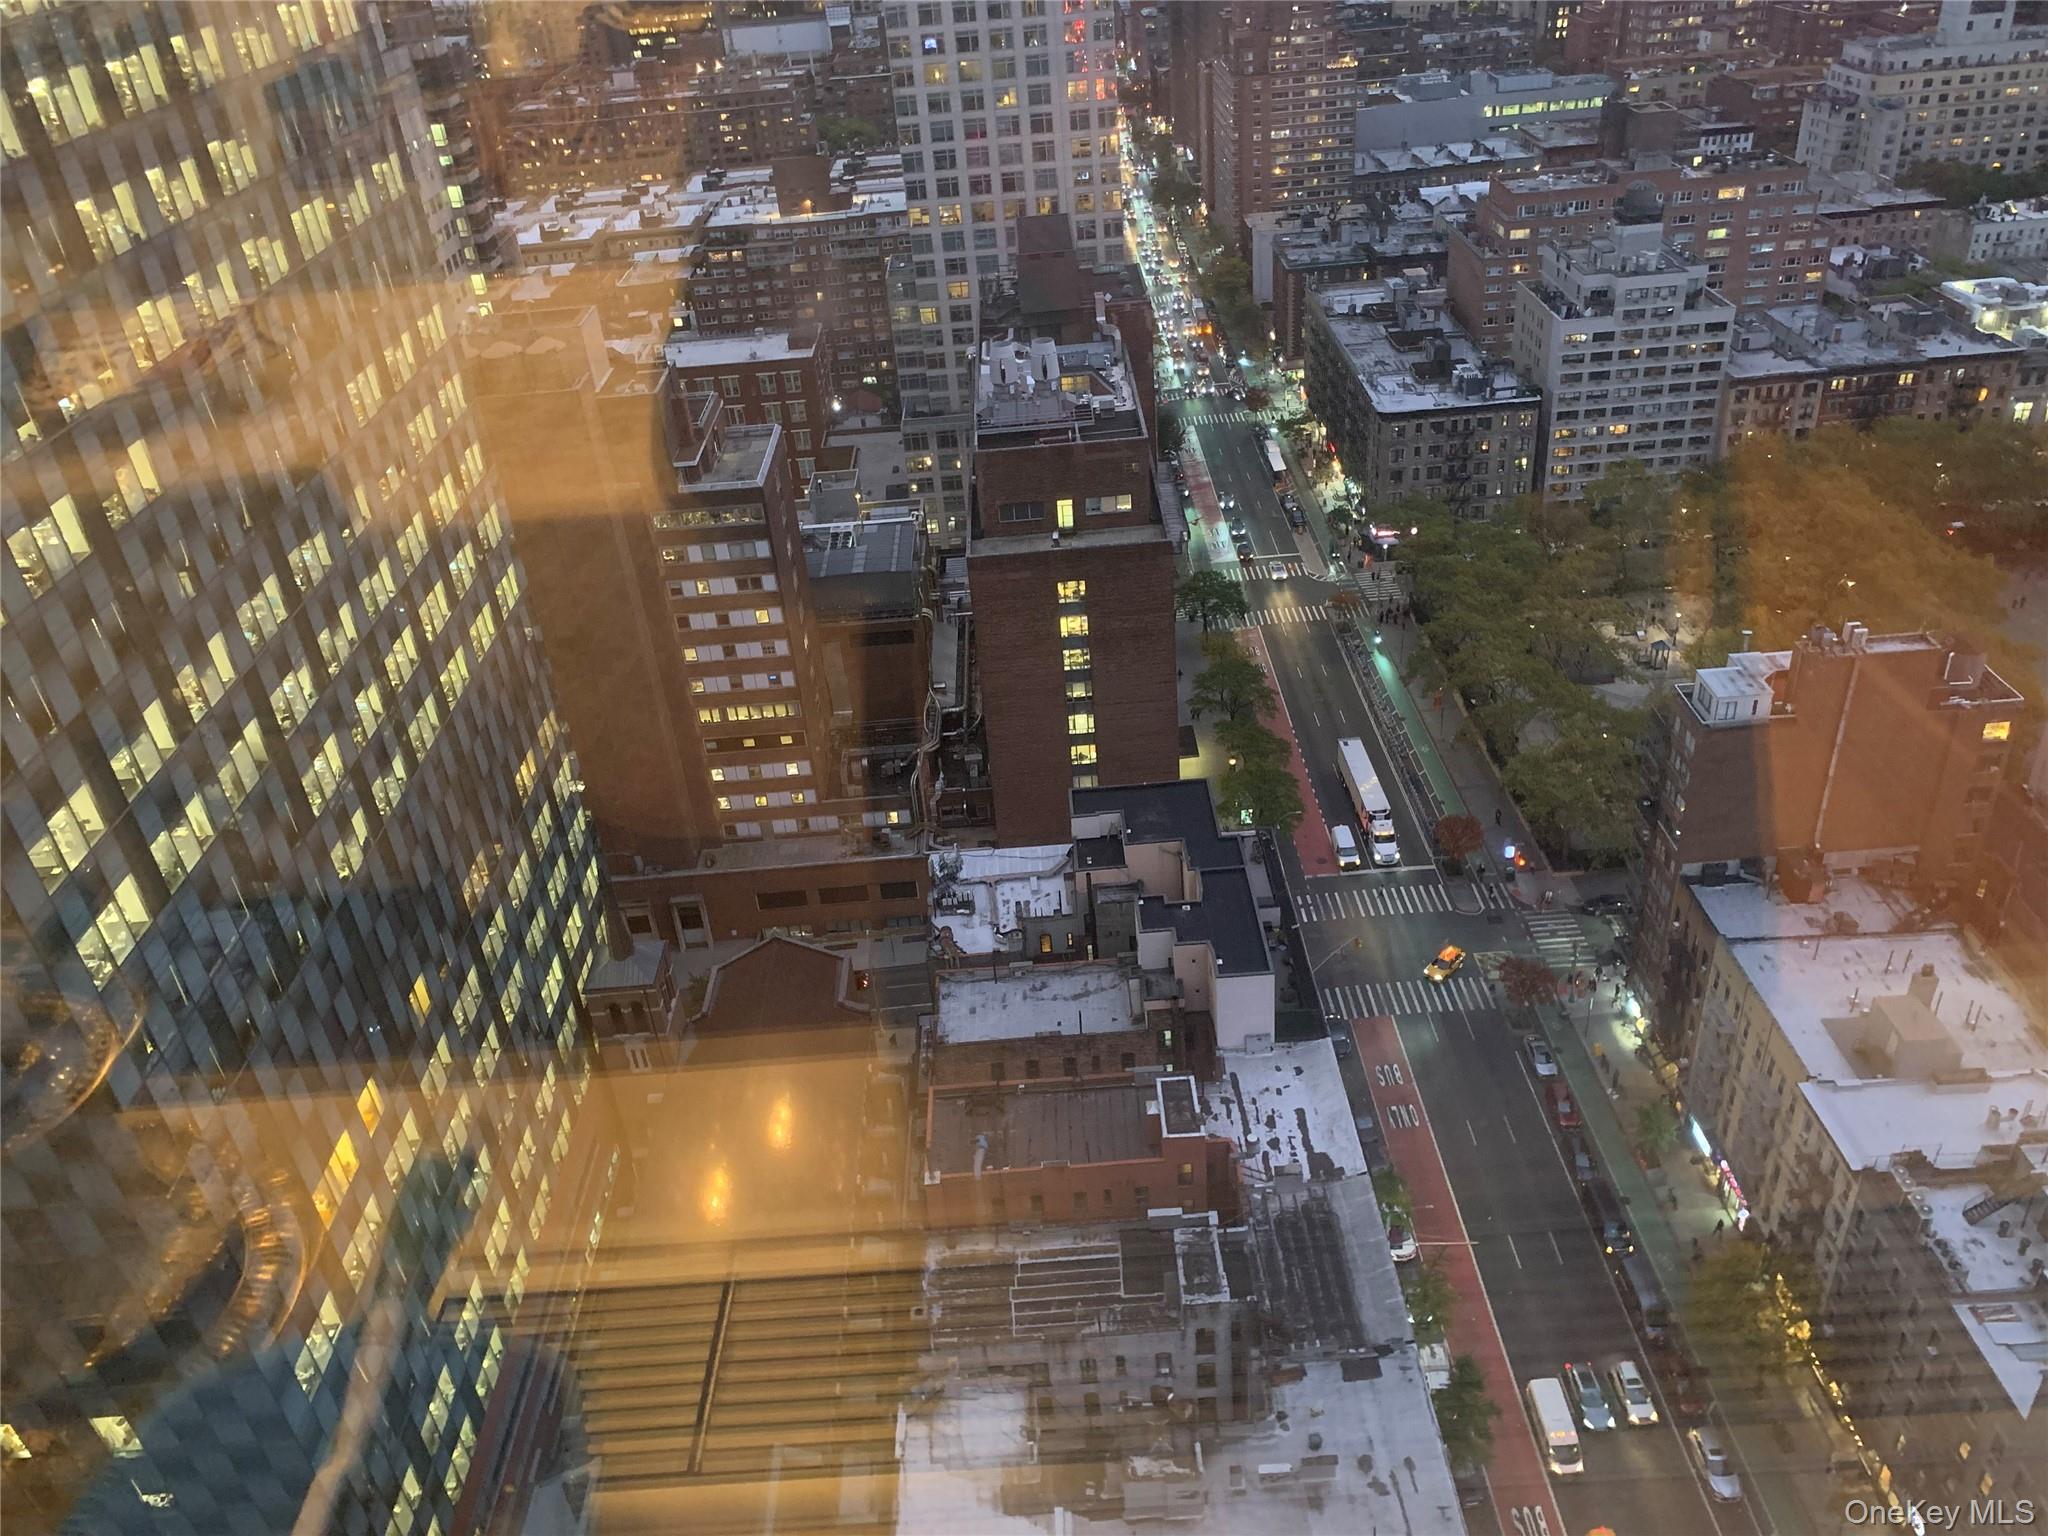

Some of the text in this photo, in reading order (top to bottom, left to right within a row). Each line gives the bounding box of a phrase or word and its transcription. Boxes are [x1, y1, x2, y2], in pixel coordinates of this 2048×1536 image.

[1375, 1063, 1404, 1087] BUS
[1386, 1104, 1420, 1129] ONLY
[1511, 1505, 1551, 1536] BUS
